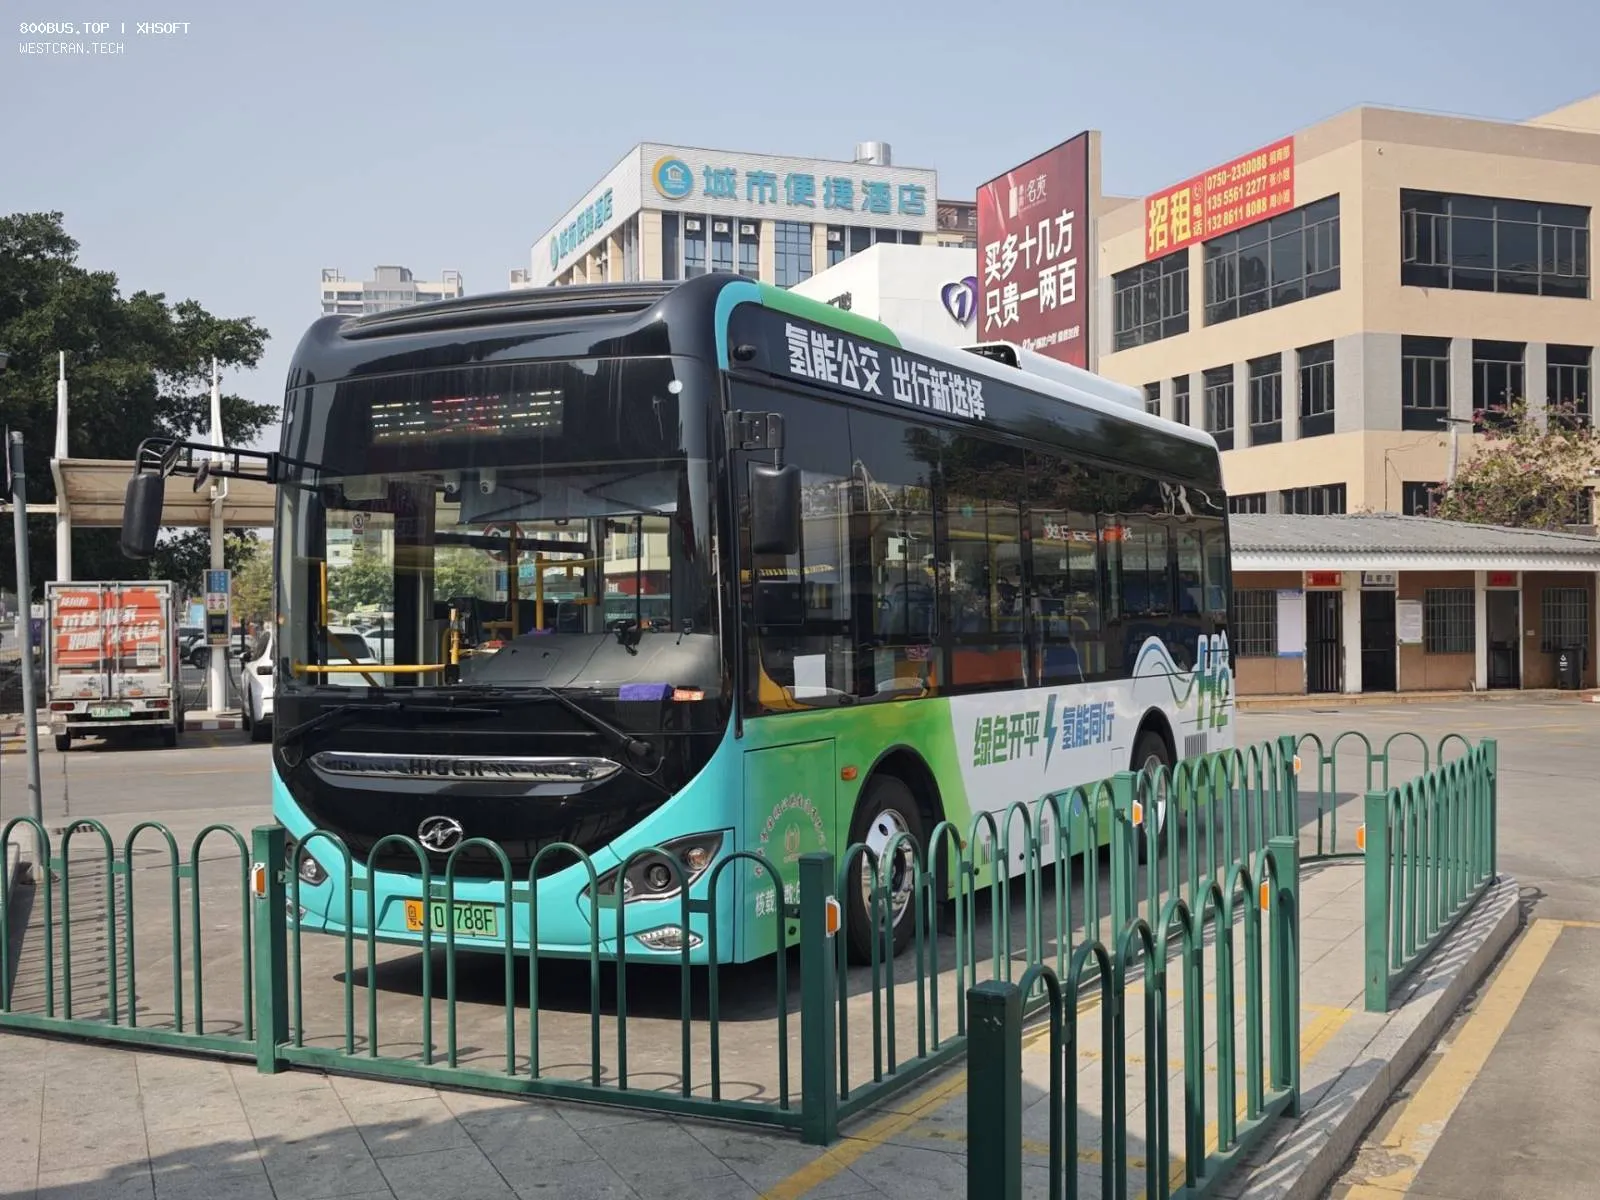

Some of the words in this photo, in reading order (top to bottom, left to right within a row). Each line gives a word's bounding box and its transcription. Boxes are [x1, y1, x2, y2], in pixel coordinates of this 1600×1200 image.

[703, 164, 926, 216] 城市便捷酒店
[1149, 187, 1192, 254] 招租
[985, 209, 1075, 286] 买多十几方
[985, 258, 1077, 333] 只贵一两百
[785, 322, 883, 396] 氢能公交
[890, 356, 986, 421] 出行新选择
[409, 758, 484, 777] HIGER
[973, 711, 1040, 767] 绿色开平
[1062, 701, 1114, 750] 氢能同行
